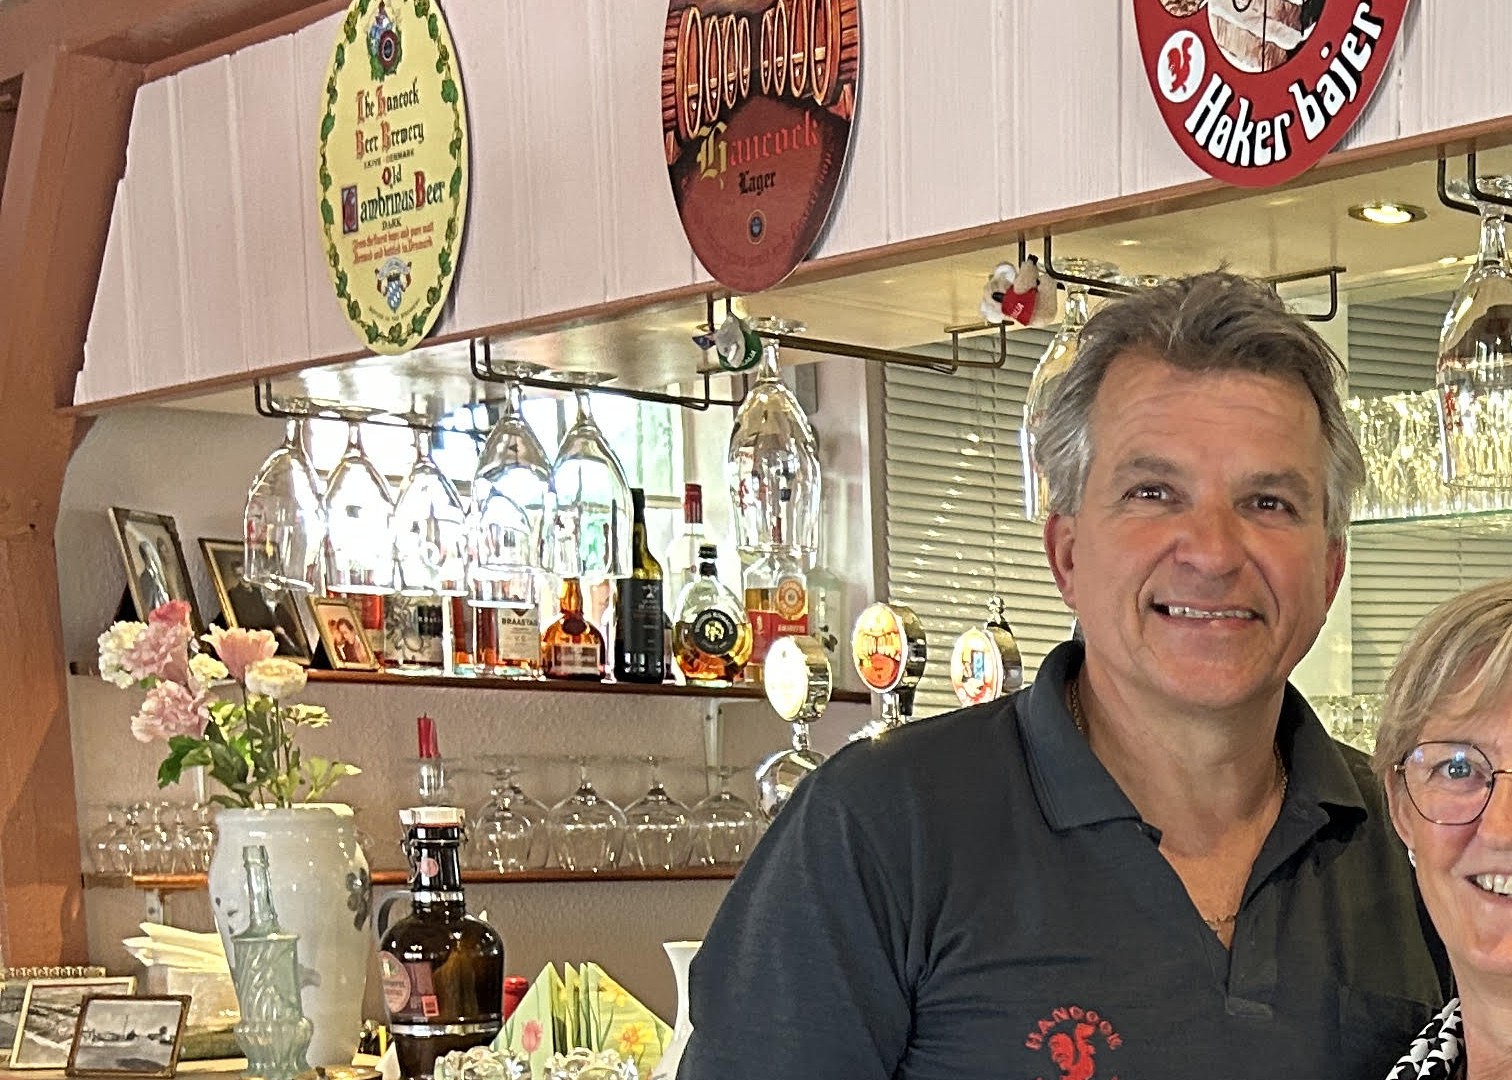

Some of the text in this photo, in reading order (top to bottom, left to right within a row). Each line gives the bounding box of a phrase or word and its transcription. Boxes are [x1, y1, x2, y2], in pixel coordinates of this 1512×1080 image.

[356, 76, 420, 124] The Hancock
[1184, 1, 1385, 167] Høker bajer
[355, 120, 425, 160] Beer Brewery
[696, 110, 819, 190] Hancock
[381, 164, 402, 186] Old
[413, 170, 446, 211] Beer
[738, 170, 777, 196] Lager
[1024, 1004, 1123, 1051] HANCOCK
